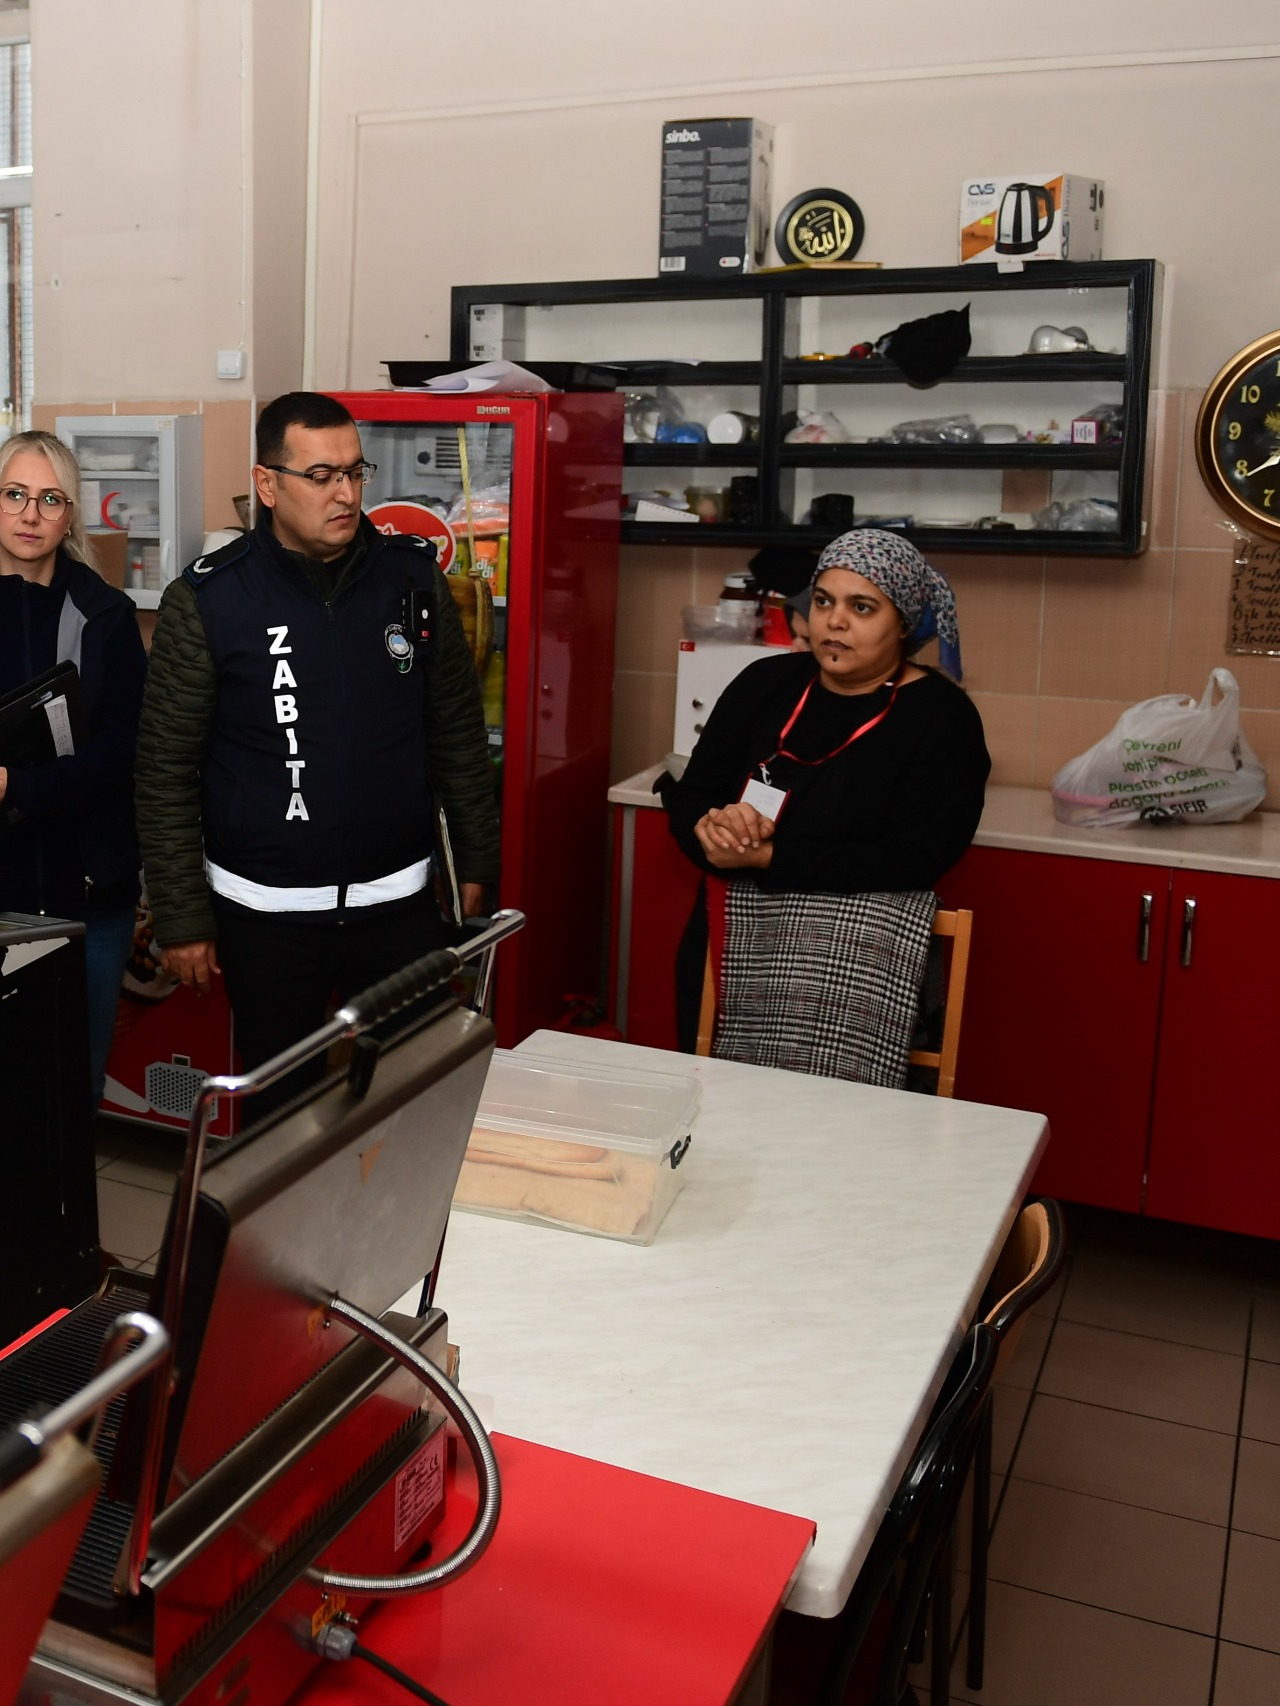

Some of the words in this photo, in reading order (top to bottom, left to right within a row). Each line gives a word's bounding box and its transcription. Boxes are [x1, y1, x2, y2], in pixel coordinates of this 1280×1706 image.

[967, 183, 996, 196] CVS
[1240, 384, 1261, 404] 10
[1228, 421, 1242, 440] 9
[1235, 459, 1248, 477] 8
[1263, 488, 1276, 507] 7
[267, 625, 310, 821] ZABITA
